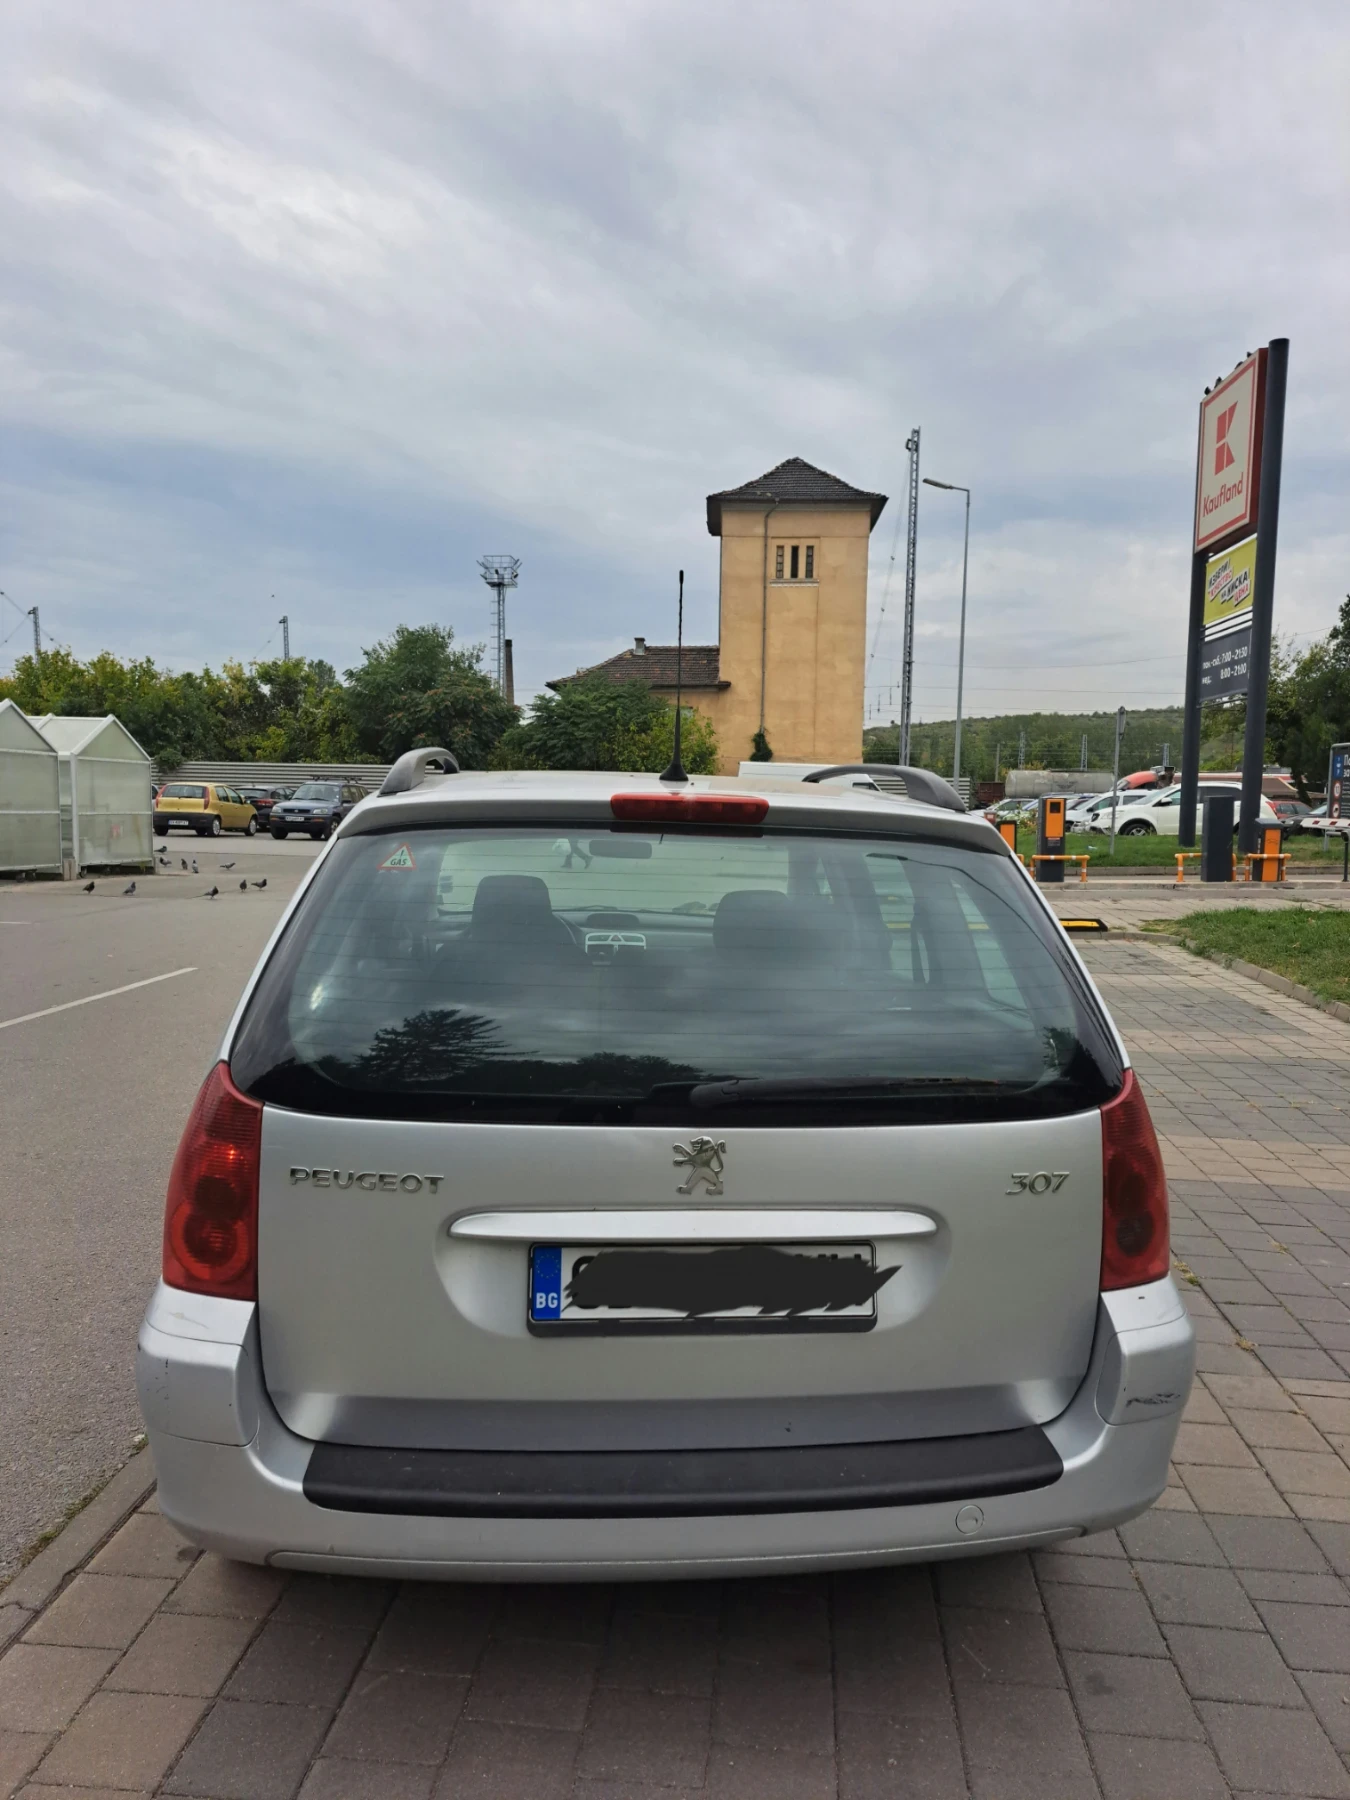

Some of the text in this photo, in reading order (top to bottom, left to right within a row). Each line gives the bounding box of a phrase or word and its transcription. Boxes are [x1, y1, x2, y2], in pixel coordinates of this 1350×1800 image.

[1203, 472, 1244, 517] Kaufland
[390, 858, 407, 866] GAS
[290, 1166, 445, 1194] PEUGEOT
[1005, 1171, 1070, 1195] 307
[536, 1292, 558, 1308] BG
